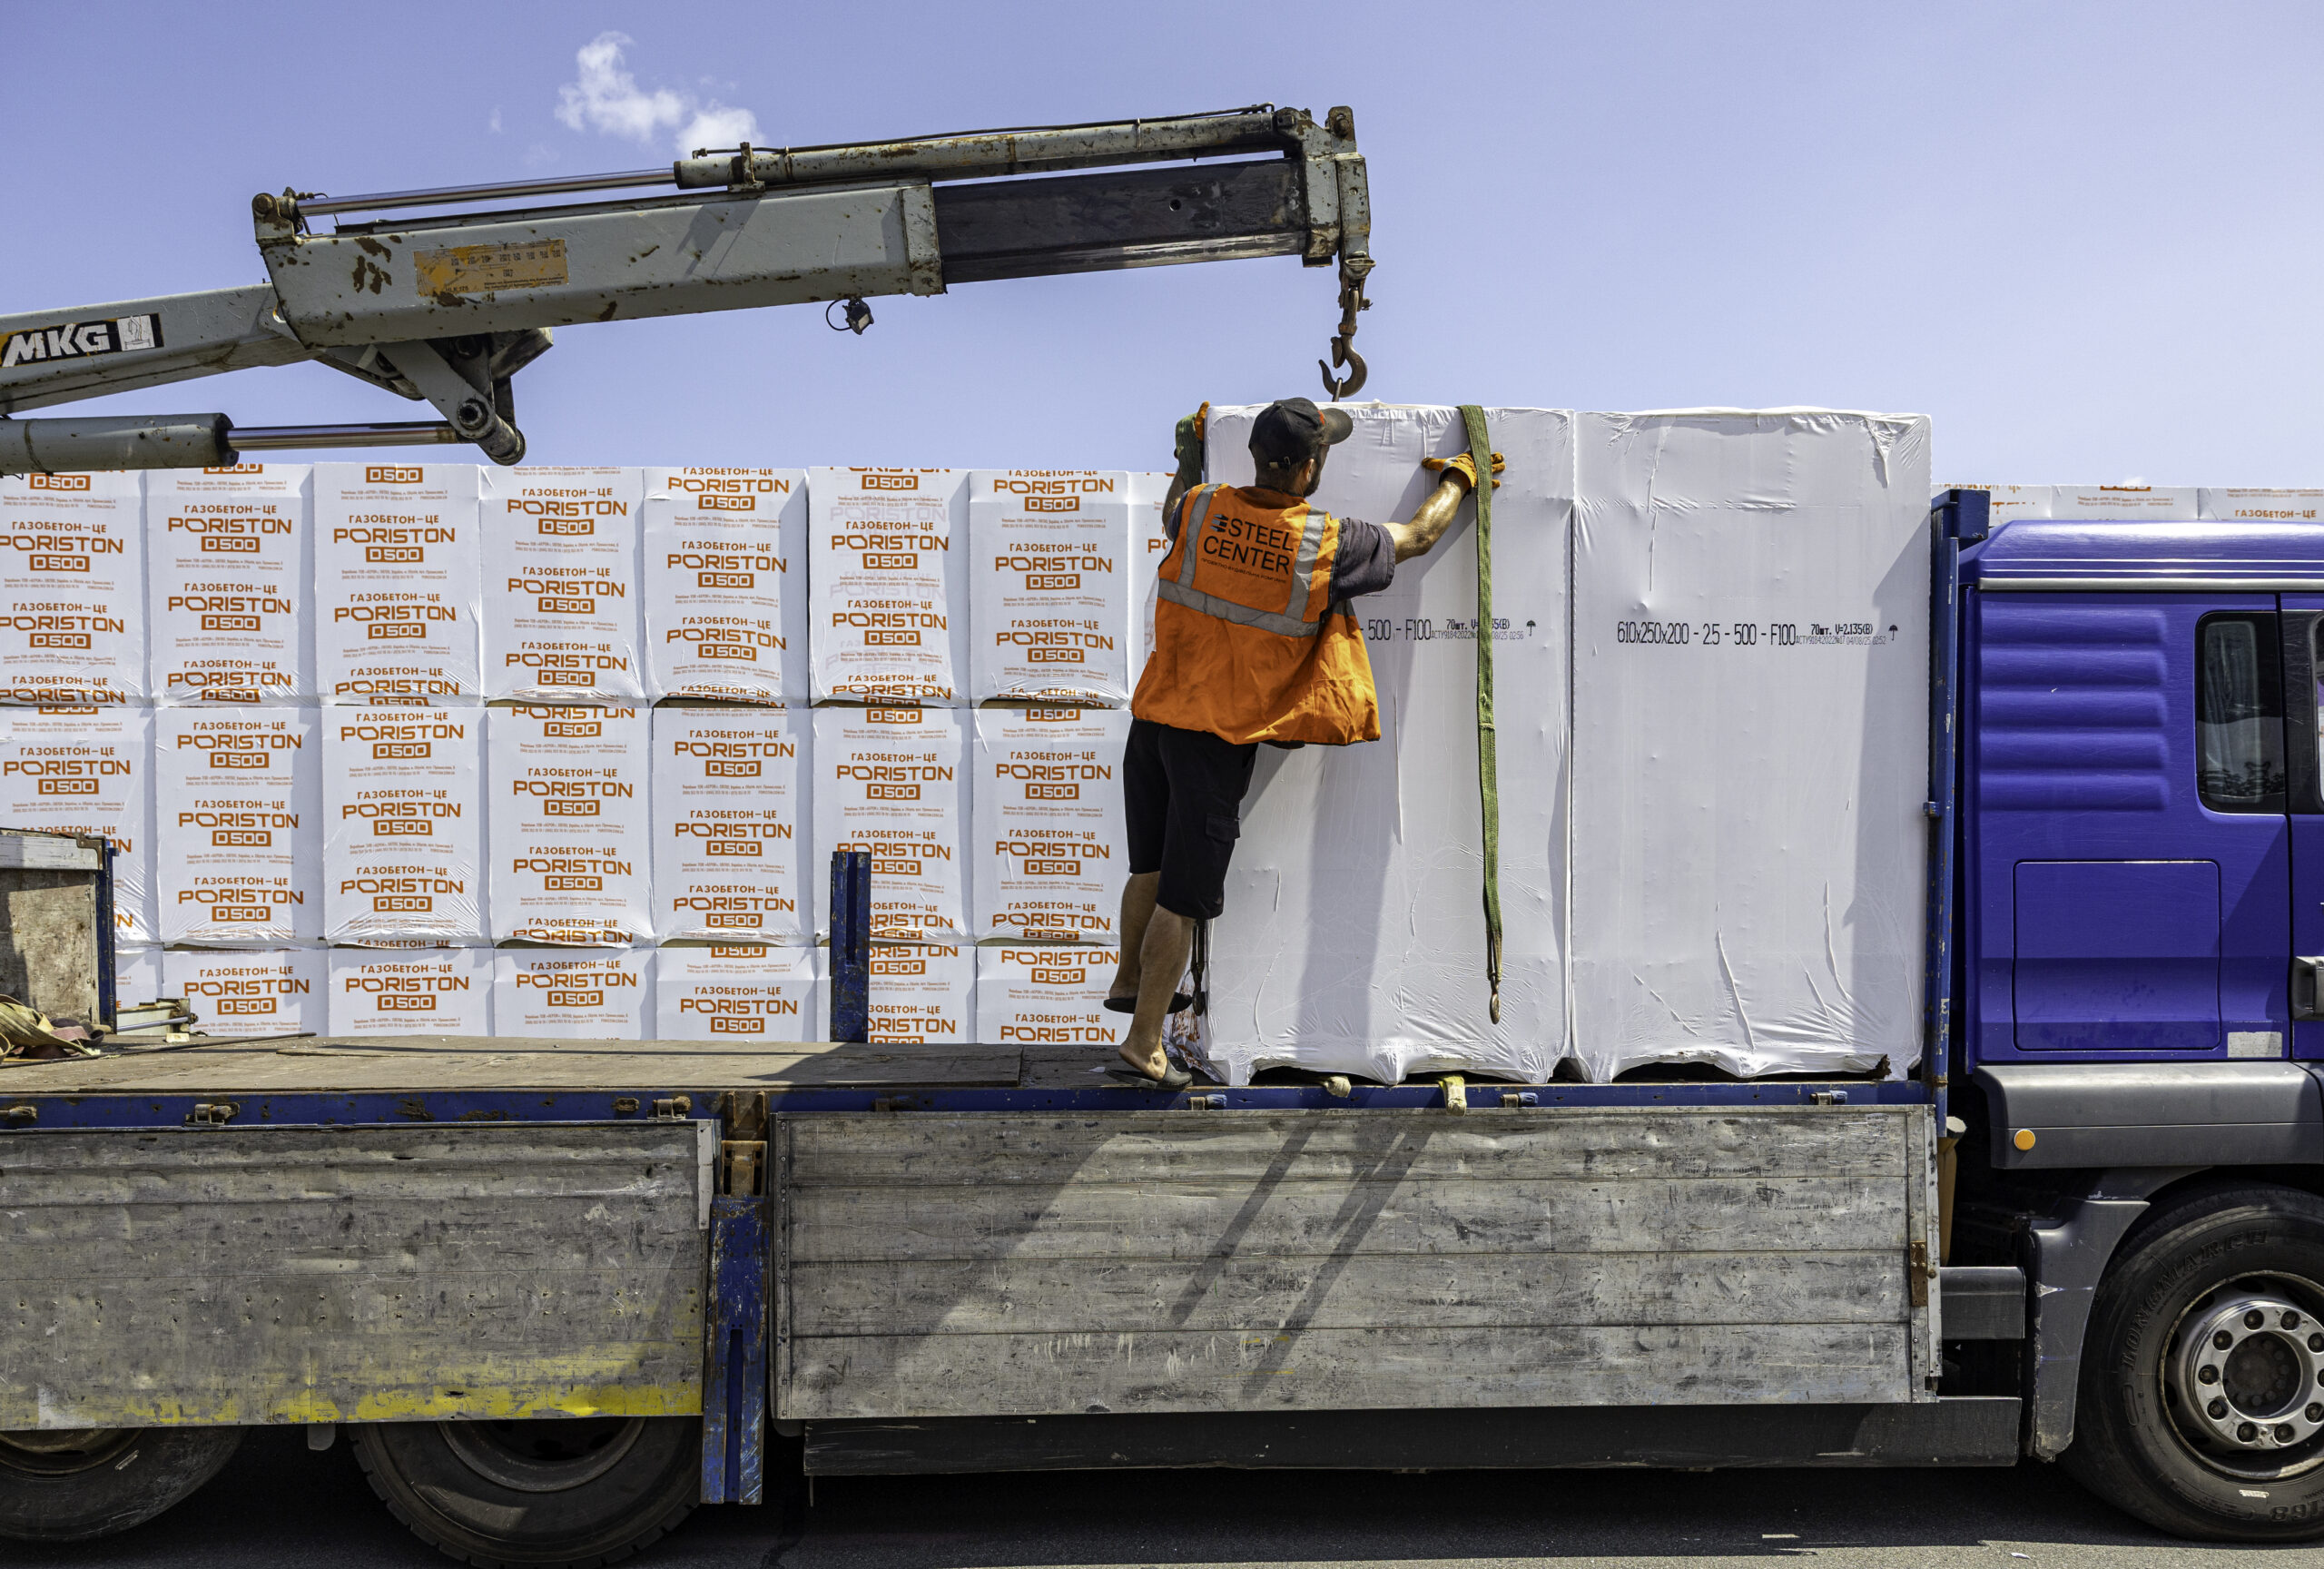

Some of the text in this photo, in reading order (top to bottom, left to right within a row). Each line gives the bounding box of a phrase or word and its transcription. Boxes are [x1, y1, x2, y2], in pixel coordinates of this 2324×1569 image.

[2, 323, 111, 368] MKG
[33, 475, 86, 489] D500
[369, 469, 419, 482] D500
[864, 477, 914, 488] D500
[667, 477, 790, 493] PORISTON
[993, 479, 1114, 494] PORISTON
[507, 499, 627, 516] PORISTON
[702, 497, 752, 509] D500
[1028, 498, 1076, 510] D500
[168, 518, 291, 534] PORISTON
[542, 520, 590, 534] D500
[333, 528, 456, 543] PORISTON
[1227, 518, 1295, 552] STEEL
[0, 536, 123, 553] PORISTON
[204, 538, 256, 550] D500
[831, 535, 949, 550] PORISTON
[369, 548, 419, 561] D500
[865, 555, 914, 567] D500
[1203, 535, 1291, 575] CENTER
[33, 557, 86, 570] D500
[667, 555, 786, 572] PORISTON
[994, 557, 1112, 572] PORISTON
[507, 578, 625, 597] PORISTON
[701, 574, 750, 587] D500
[1029, 576, 1077, 588] D500
[168, 597, 291, 613] PORISTON
[541, 599, 591, 612] D500
[334, 606, 457, 622] PORISTON
[0, 615, 124, 634] PORISTON
[204, 617, 257, 629] D500
[832, 613, 947, 630] PORISTON
[371, 625, 422, 637] D500
[1368, 618, 1392, 641] 500
[1405, 618, 1432, 641] F100
[1617, 621, 1689, 645] 610x250x200
[1702, 623, 1720, 646] 2.5
[1734, 623, 1757, 646] 500
[1770, 623, 1797, 646] F100
[33, 635, 87, 647] D500
[666, 628, 786, 649] PORISTON
[867, 632, 917, 644] D500
[996, 632, 1114, 650] PORISTON
[701, 646, 753, 659] D500
[1030, 650, 1080, 661] D500
[506, 654, 627, 670] PORISTON
[167, 672, 291, 686] PORISTON
[541, 672, 592, 685] D500
[335, 680, 460, 695] PORISTON
[832, 684, 952, 701] PORISTON
[511, 705, 635, 719] PORISTON
[870, 709, 919, 722] D500
[1029, 708, 1077, 720] D500
[340, 725, 465, 741] PORISTON
[547, 724, 597, 735] D500
[177, 735, 302, 749] PORISTON
[376, 745, 427, 757] D500
[675, 742, 794, 757] PORISTON
[213, 754, 265, 767] D500
[3, 761, 132, 775] PORISTON
[708, 763, 757, 775] D500
[836, 765, 953, 781] PORISTON
[996, 764, 1111, 780] PORISTON
[41, 780, 95, 793] D500
[513, 781, 633, 797] PORISTON
[870, 785, 917, 798] D500
[1029, 785, 1075, 798] D500
[342, 803, 462, 819] PORISTON
[547, 802, 596, 814] D500
[178, 813, 299, 828] PORISTON
[377, 821, 428, 834] D500
[215, 832, 268, 844] D500
[675, 824, 793, 838] PORISTON
[709, 843, 759, 854] D500
[995, 842, 1110, 858] PORISTON
[513, 859, 633, 875] PORISTON
[1027, 862, 1077, 873] D500
[340, 879, 464, 893] PORISTON
[547, 877, 599, 889] D500
[178, 889, 304, 903] PORISTON
[377, 898, 428, 910] D500
[673, 897, 794, 912] PORISTON
[215, 908, 267, 920] D500
[709, 915, 759, 926] D500
[869, 914, 954, 928] RISTON
[992, 913, 1111, 931] PORISTON
[869, 944, 959, 958] RISTON
[1001, 951, 1119, 966] PORISTON
[872, 962, 922, 973] D500
[516, 973, 637, 988] PORISTON
[1034, 970, 1082, 982] D500
[183, 980, 310, 996] PORISTON
[345, 977, 469, 992] PORISTON
[380, 997, 432, 1009] D500
[550, 992, 599, 1005] D500
[220, 1000, 272, 1013] D500
[680, 999, 798, 1014] PORISTON
[714, 1019, 761, 1031] D500
[867, 1018, 956, 1033] RISTON
[1000, 1026, 1116, 1042] PORISTON
